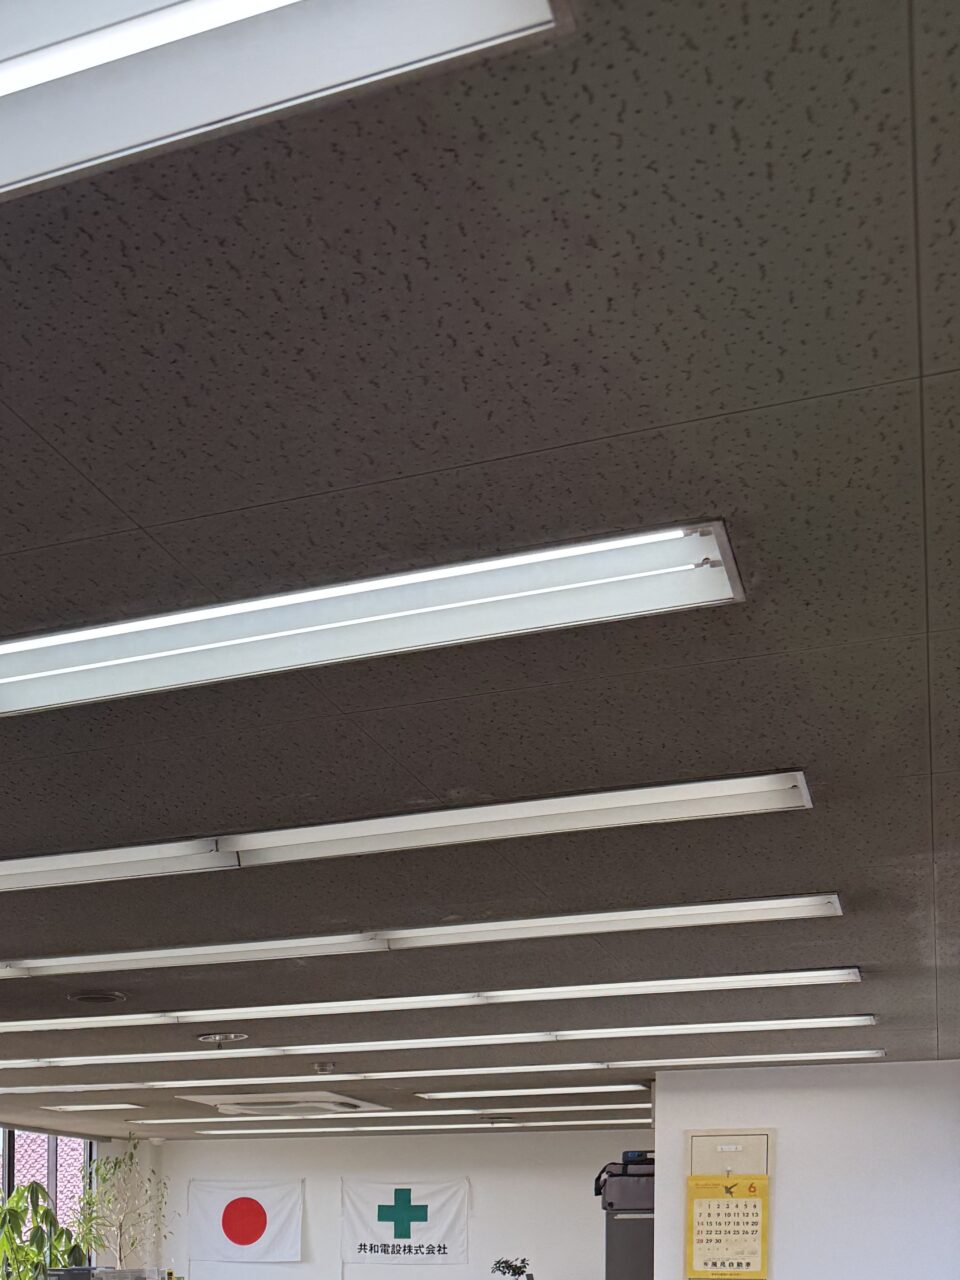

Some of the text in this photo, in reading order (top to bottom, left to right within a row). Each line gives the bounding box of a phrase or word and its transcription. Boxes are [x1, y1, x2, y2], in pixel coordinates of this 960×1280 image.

[748, 1182, 756, 1193] 6
[357, 1242, 448, 1255] 共和電設株式会社
